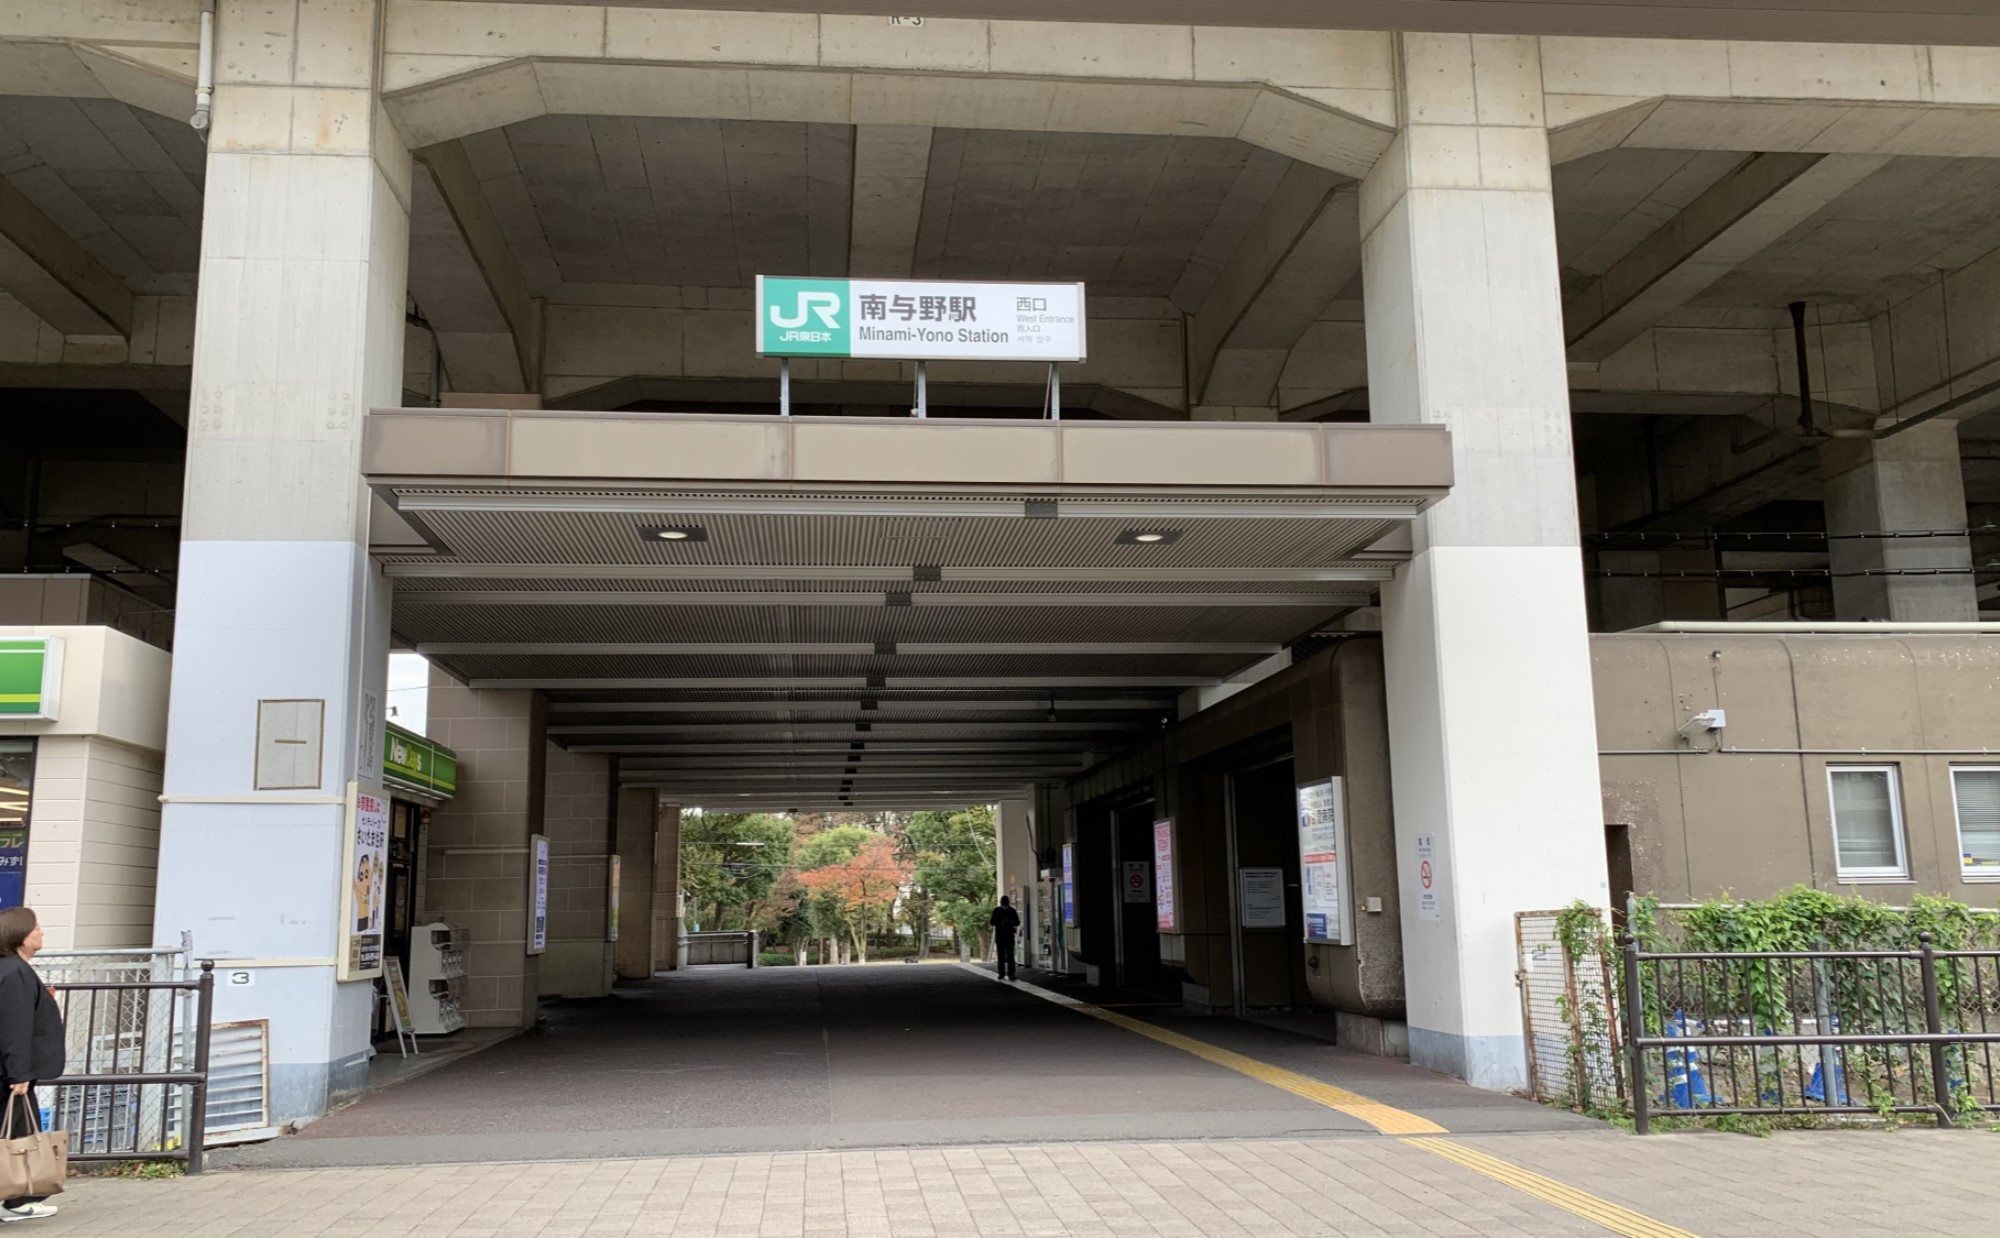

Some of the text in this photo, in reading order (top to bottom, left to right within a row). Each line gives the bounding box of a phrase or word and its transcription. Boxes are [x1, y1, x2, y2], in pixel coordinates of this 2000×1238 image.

[770, 291, 840, 328] JR
[859, 294, 976, 322] 南与野駅
[1016, 297, 1047, 311] 西口
[1016, 314, 1074, 323] West Entrance
[780, 331, 832, 342] JR東日本
[859, 327, 1008, 343] Minami-Yono Station
[232, 972, 249, 984] 3
